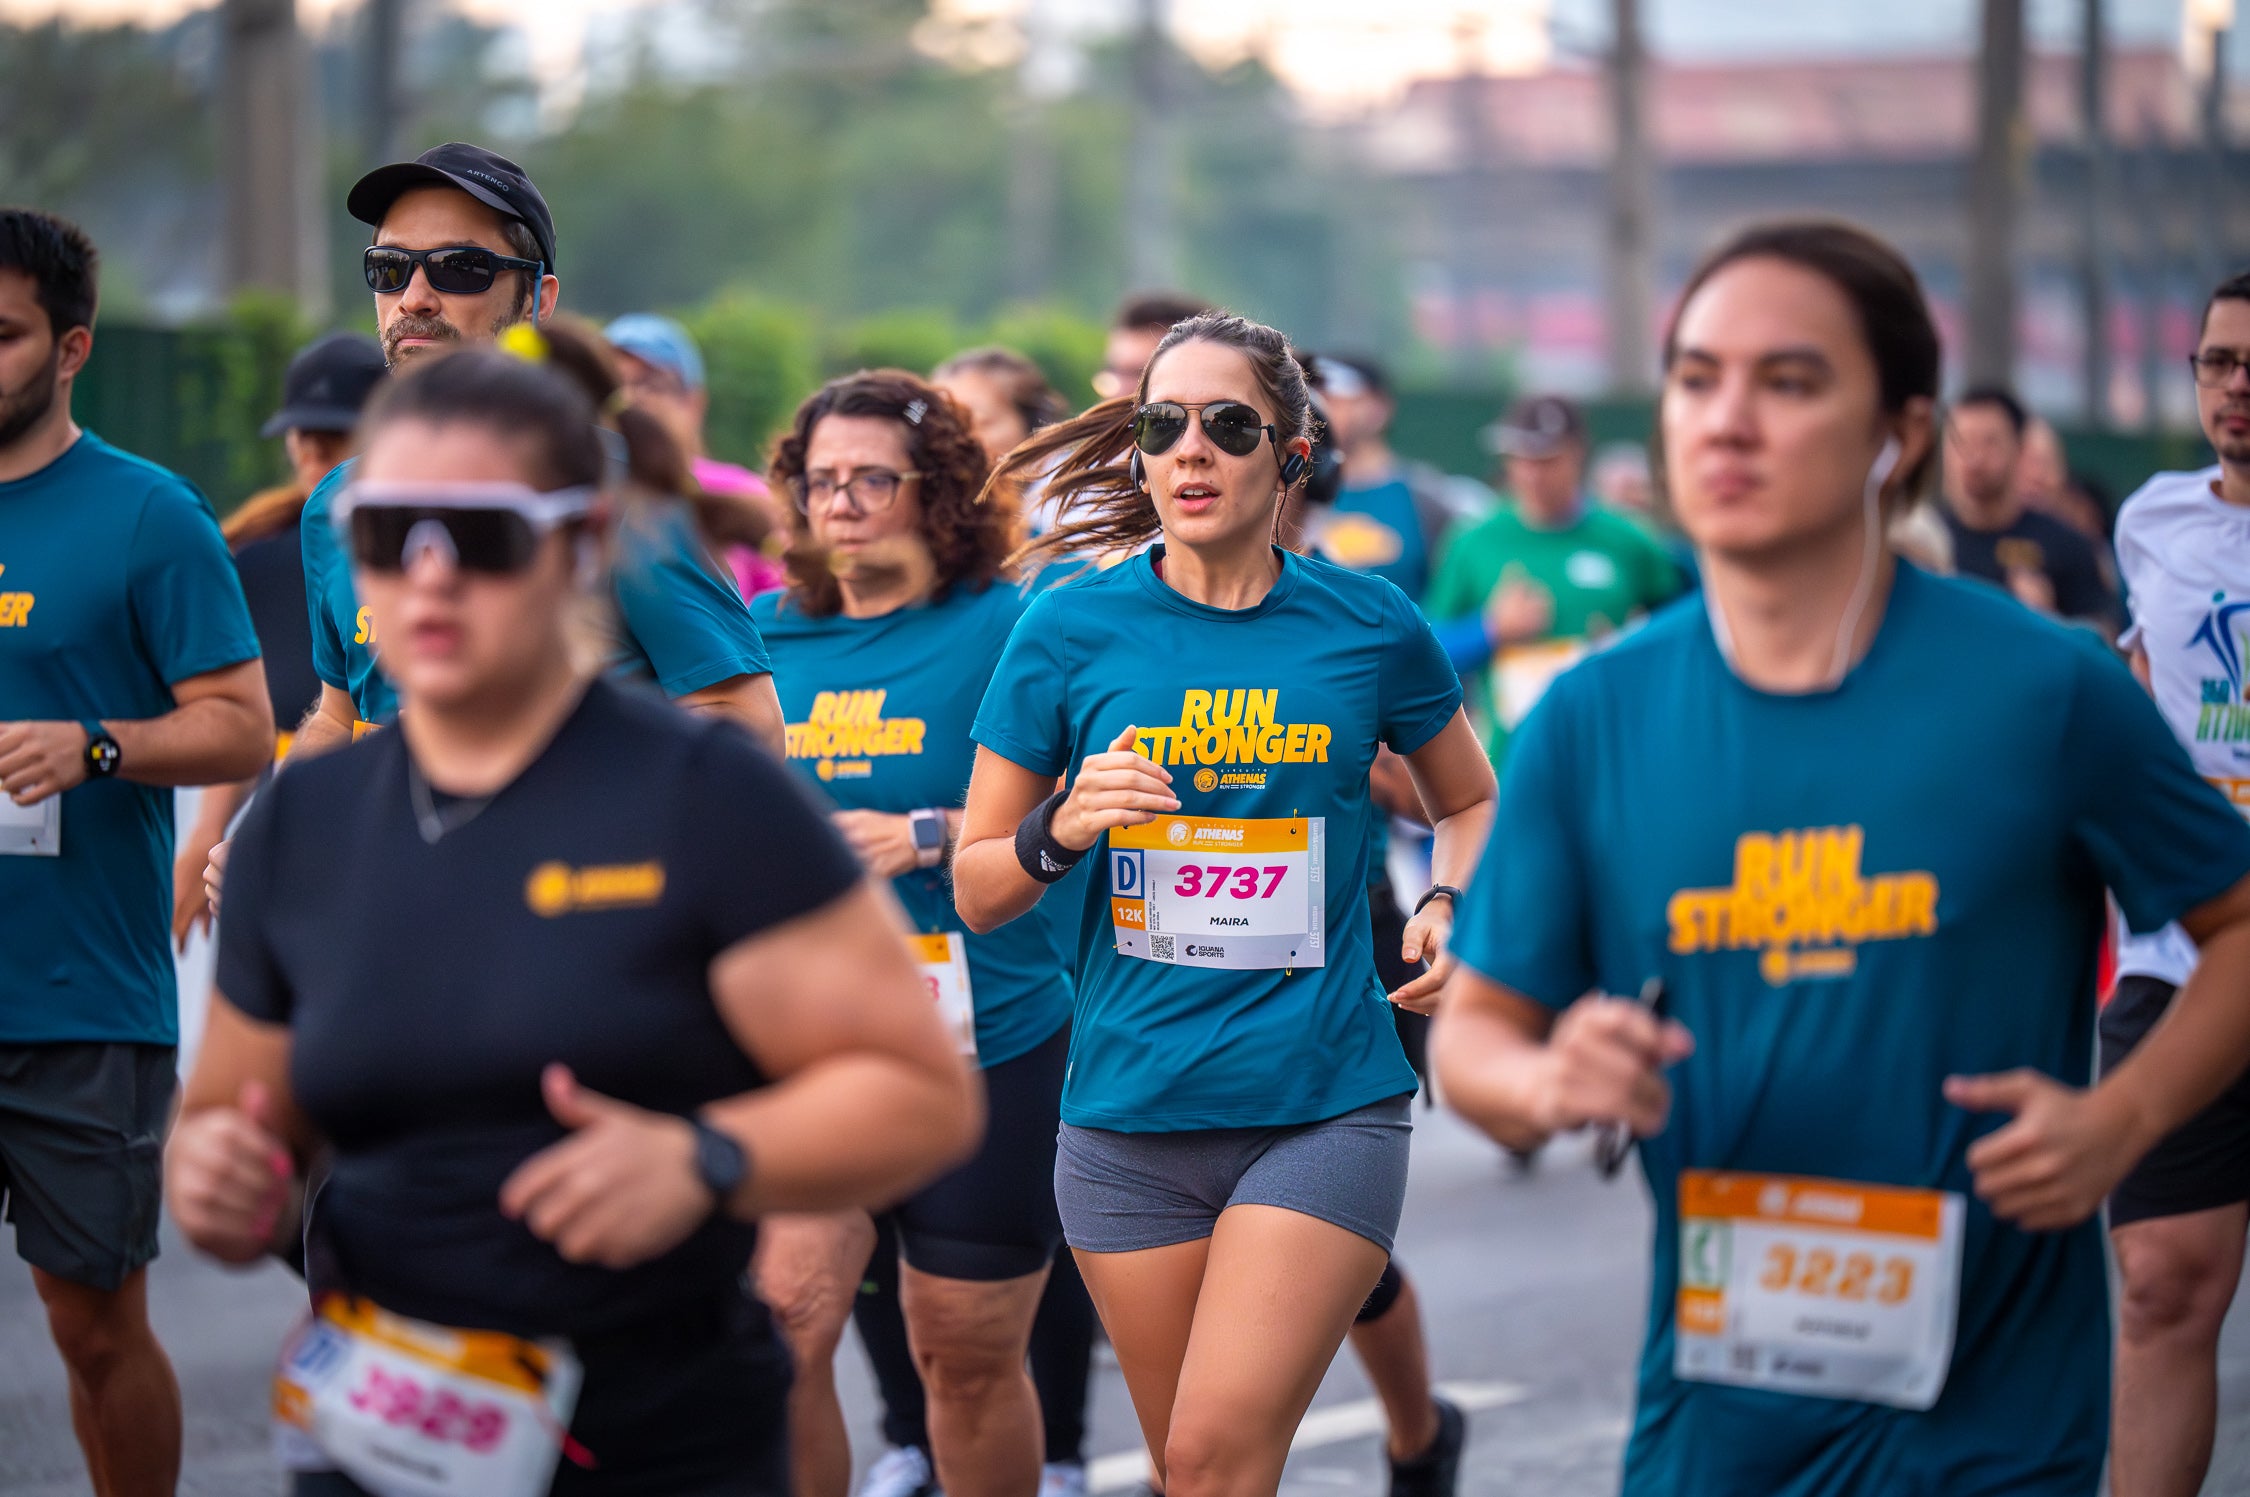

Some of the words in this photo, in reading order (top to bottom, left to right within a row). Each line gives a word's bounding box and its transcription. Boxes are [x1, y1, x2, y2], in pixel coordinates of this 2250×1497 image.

[808, 688, 887, 726] RUN
[1180, 689, 1278, 729] RUN
[785, 718, 926, 758] TRONGER
[1130, 724, 1332, 766] STRONGER
[1219, 773, 1267, 785] ATHENAS
[1194, 828, 1244, 841] ATHENAS
[1118, 856, 1136, 890] D
[1733, 823, 1865, 899] RUN
[1174, 865, 1288, 899] 3737
[1117, 907, 1143, 923] 12K
[1209, 917, 1249, 926] MAIRA
[1667, 869, 1939, 954] STRONGER
